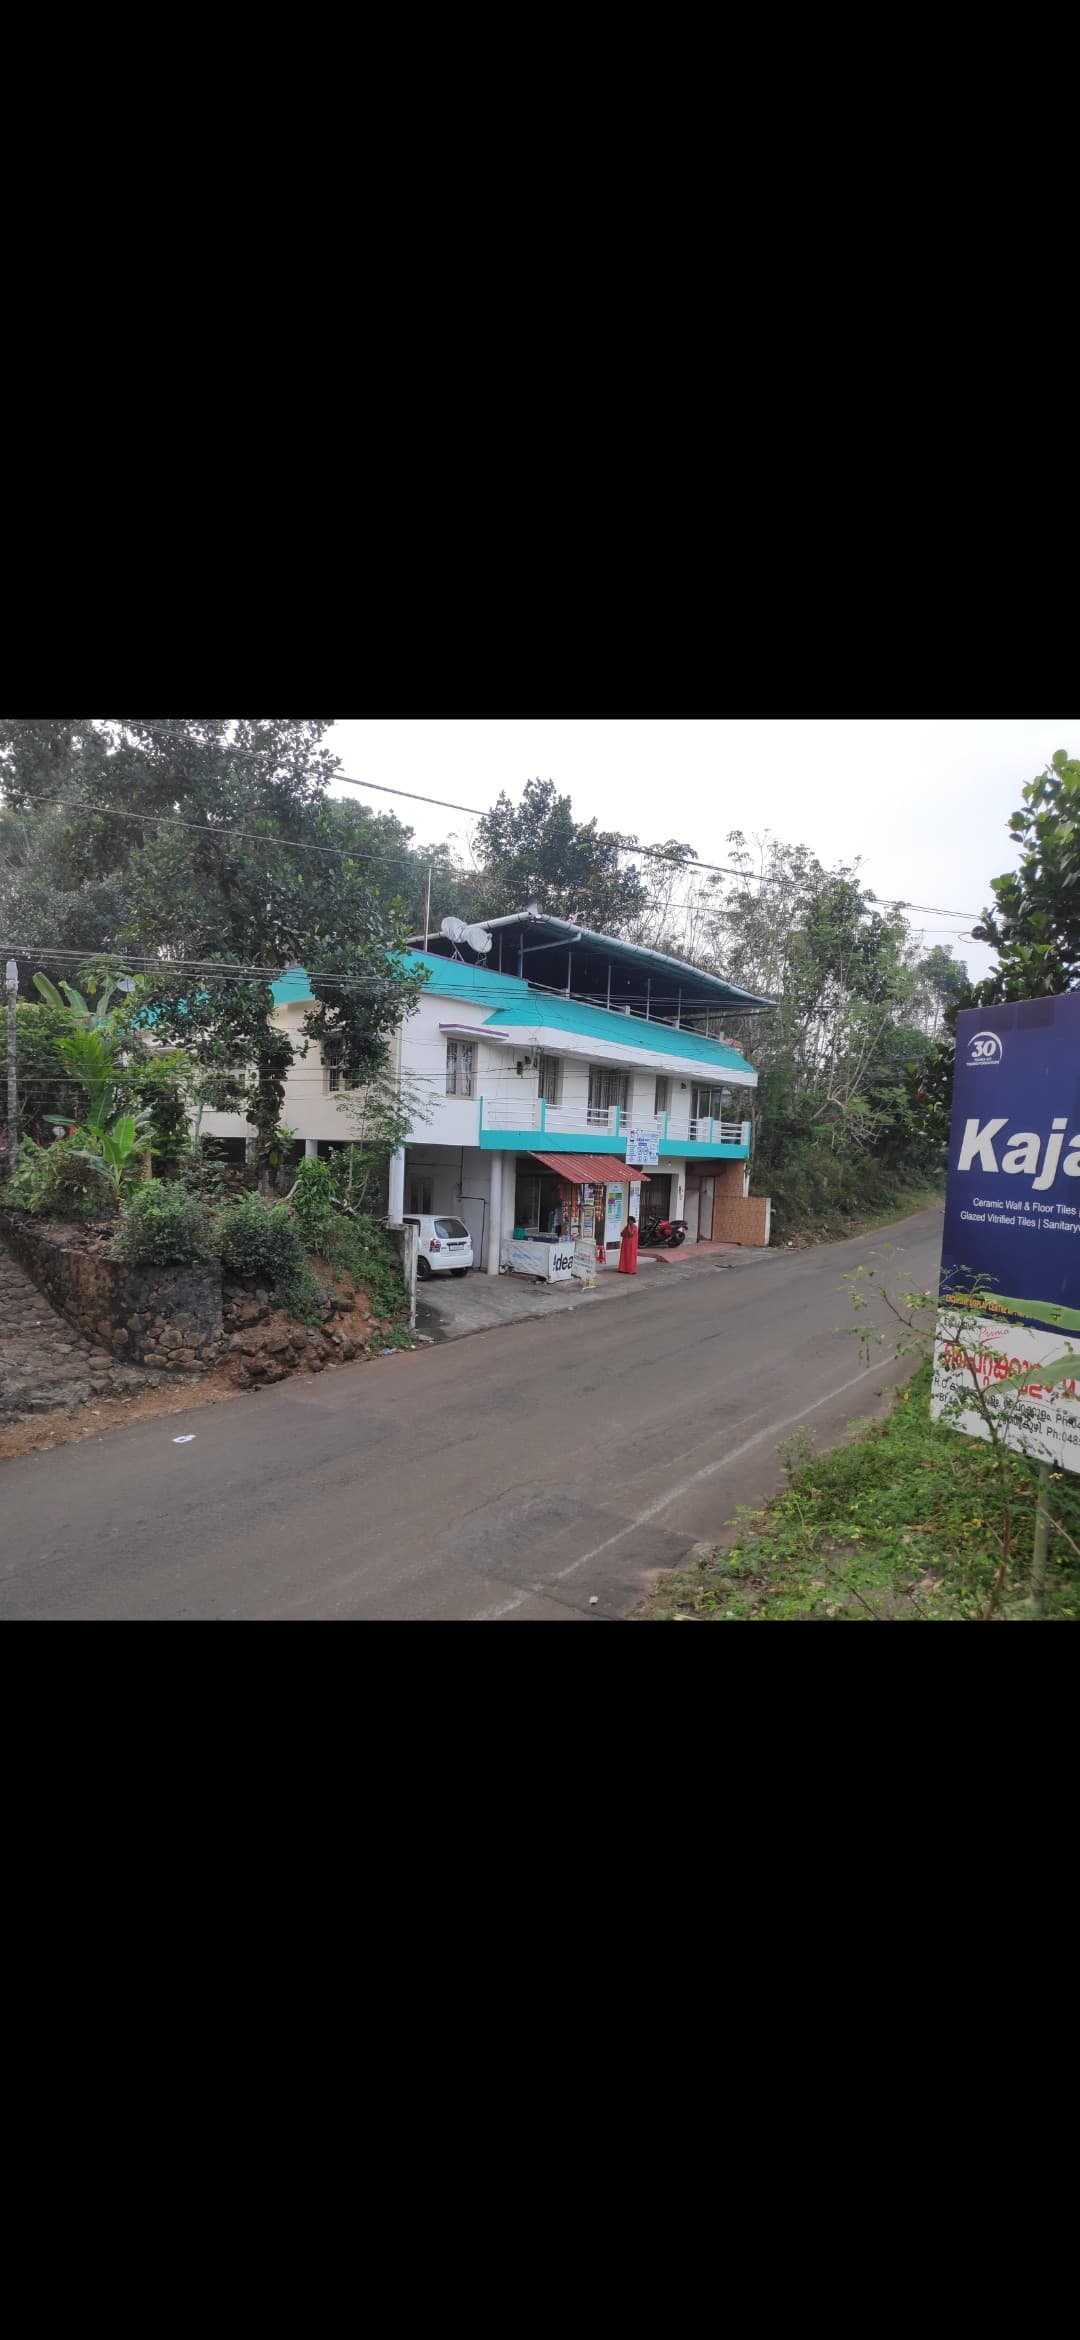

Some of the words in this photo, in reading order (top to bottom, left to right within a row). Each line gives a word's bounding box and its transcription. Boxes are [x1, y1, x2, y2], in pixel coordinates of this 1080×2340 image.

[971, 1040, 997, 1058] 30
[973, 1198, 1004, 1210] Ceramic
[1006, 1200, 1022, 1211] Wall
[1024, 1202, 1031, 1212] &
[1033, 1203, 1055, 1214] Floor
[1056, 1204, 1077, 1216] Tiles
[960, 1210, 986, 1223] Glazed
[987, 1214, 1016, 1225] Vitrified
[1018, 1217, 1036, 1228] Tiles
